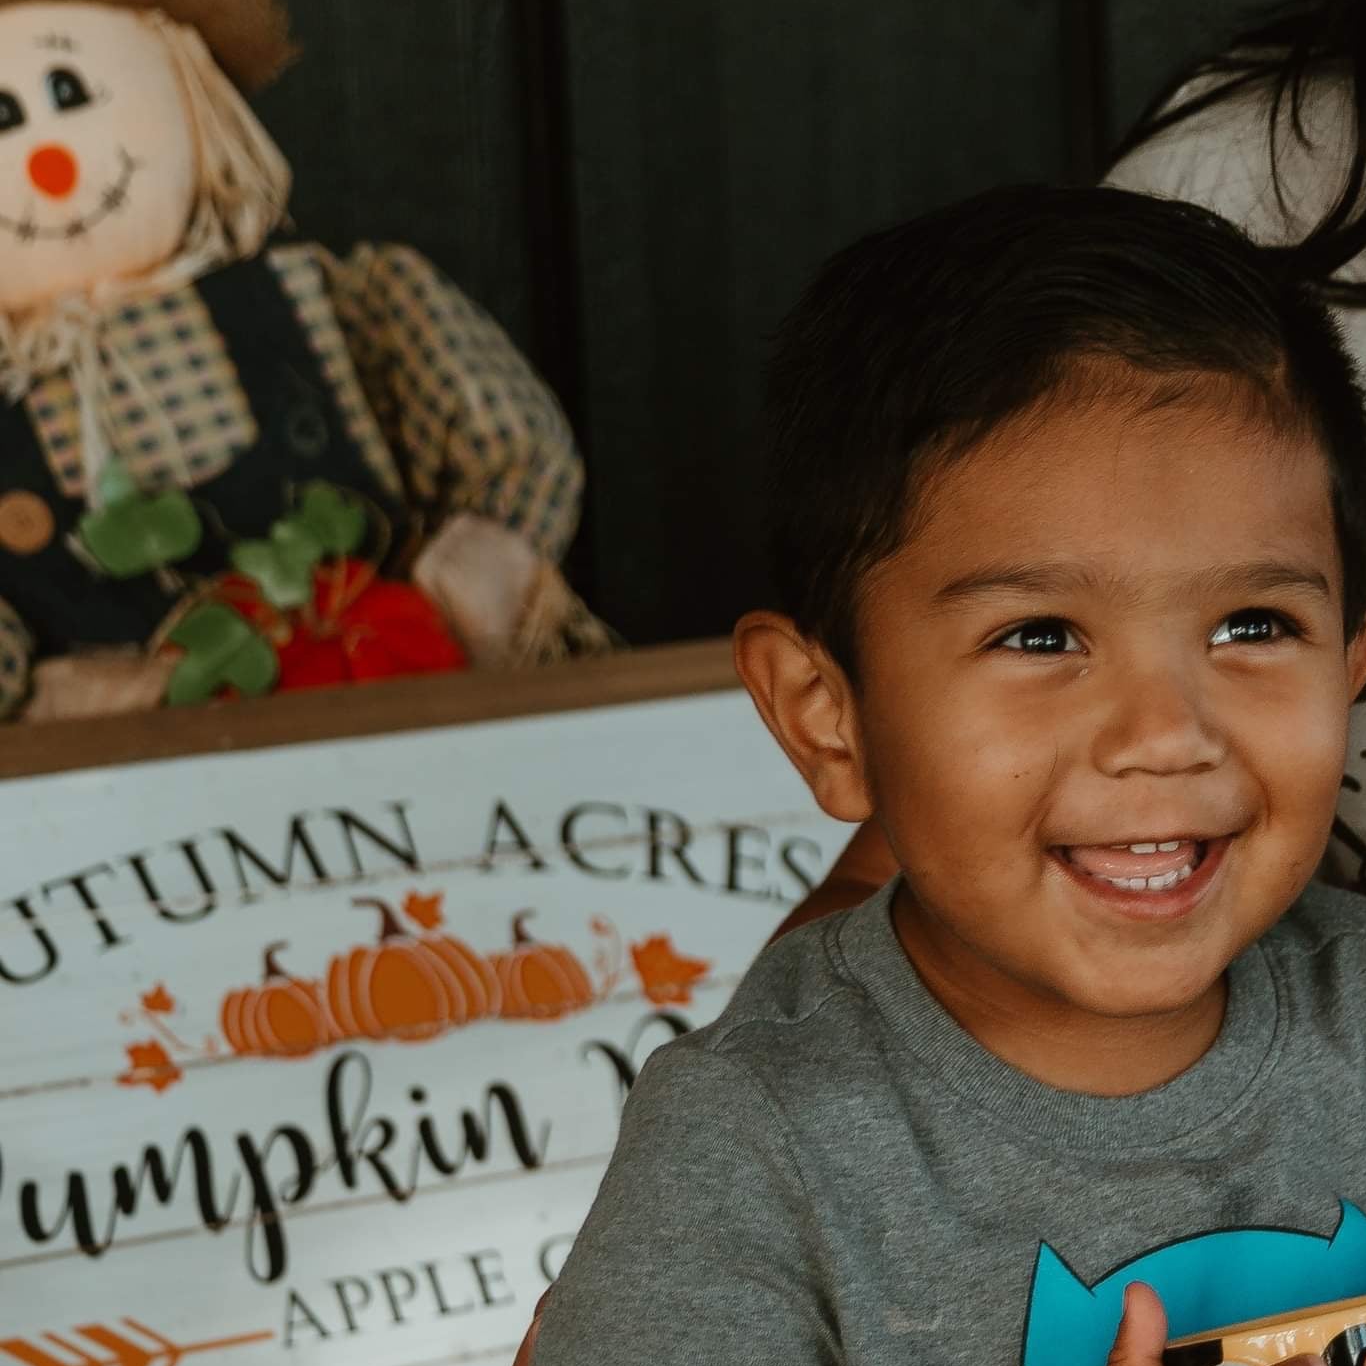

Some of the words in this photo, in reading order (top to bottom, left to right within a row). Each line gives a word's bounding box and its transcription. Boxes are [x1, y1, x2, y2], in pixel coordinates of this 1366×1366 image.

[0, 799, 427, 985] UTUMN
[476, 797, 824, 909] ACRES
[0, 1051, 552, 1284] umpkin
[281, 1247, 516, 1349] APPLE
